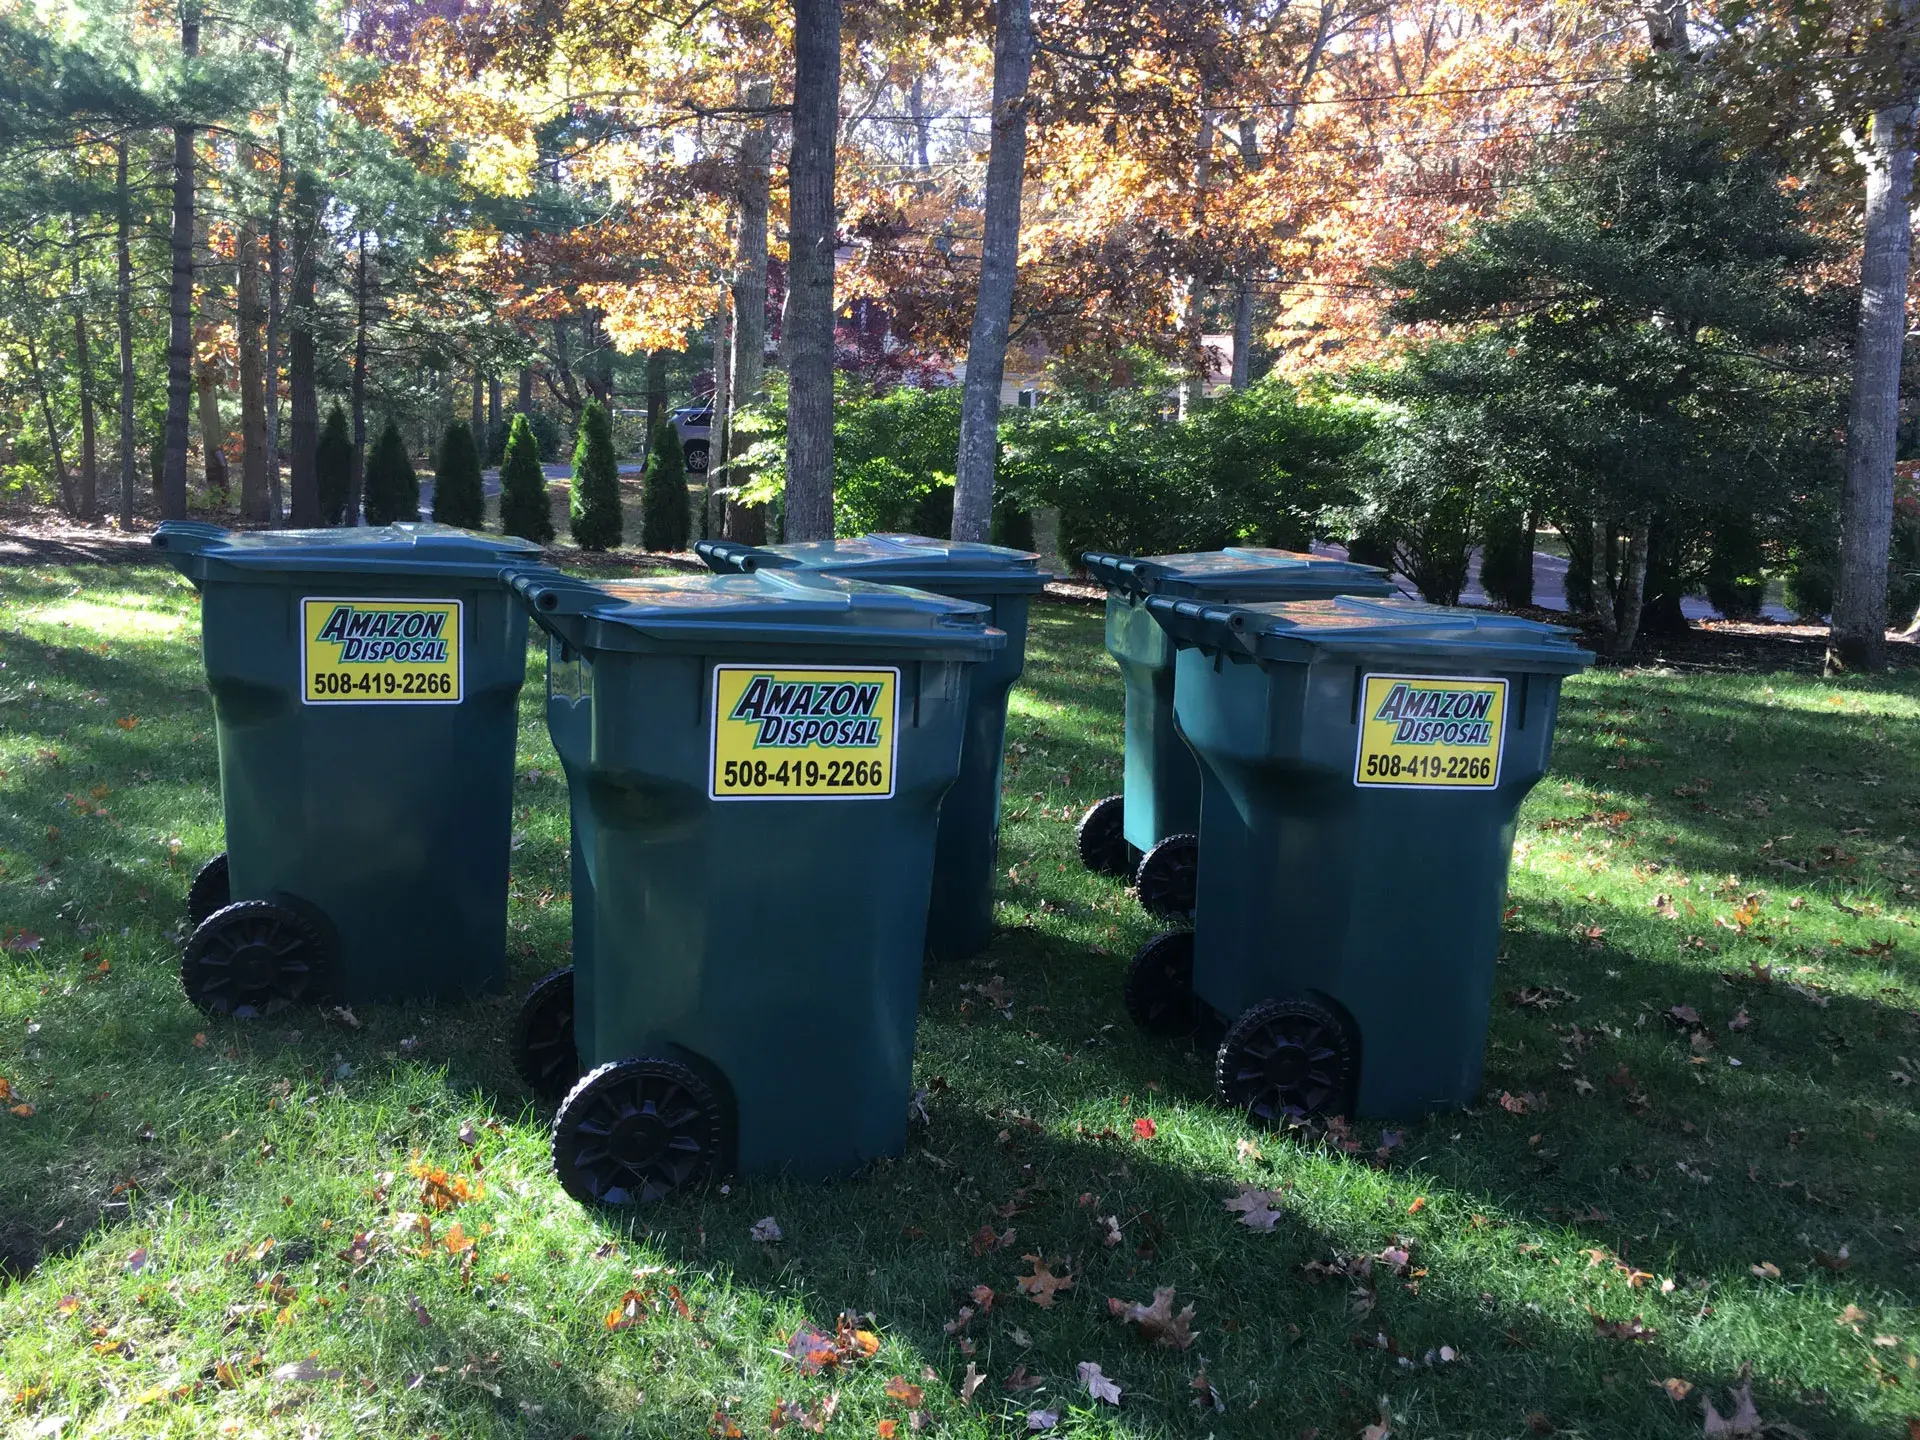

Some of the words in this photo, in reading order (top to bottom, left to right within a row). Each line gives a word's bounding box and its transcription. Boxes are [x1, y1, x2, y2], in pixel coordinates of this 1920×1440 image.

[319, 606, 447, 641] AMAZON
[342, 638, 447, 662] DISPOSAL
[314, 672, 451, 694] 508-419-2266
[732, 676, 882, 720] AMAZON
[1375, 684, 1494, 721] AMAZON
[756, 715, 881, 747] DISPOSAL
[1394, 718, 1492, 745] DISPOSAL
[724, 760, 883, 788] 508-419-2266
[1366, 754, 1491, 780] 508-419-2266
